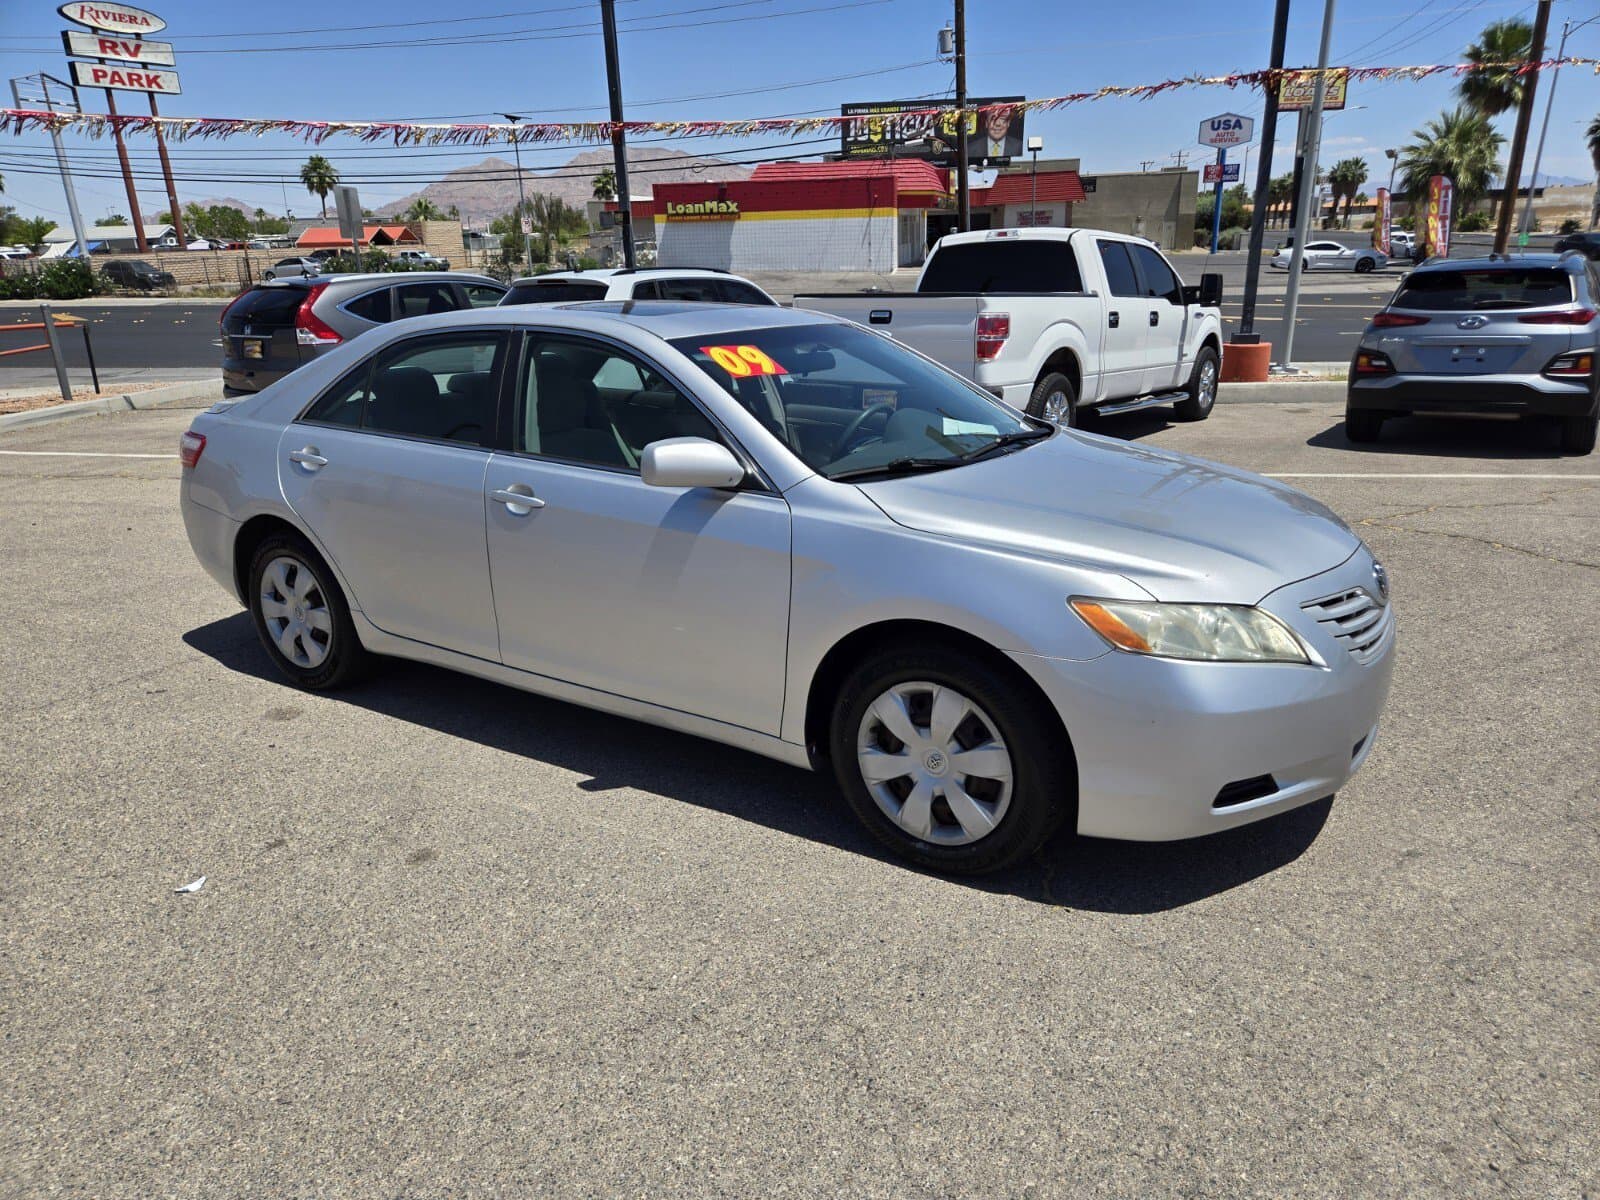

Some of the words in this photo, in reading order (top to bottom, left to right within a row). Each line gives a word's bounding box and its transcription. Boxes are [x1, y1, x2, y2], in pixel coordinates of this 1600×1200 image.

[79, 5, 151, 27] RIVIERA
[98, 38, 142, 58] RV
[92, 68, 164, 90] PARK
[1210, 119, 1243, 131] USA
[666, 200, 739, 215] LoanMax
[709, 345, 776, 376] 09
